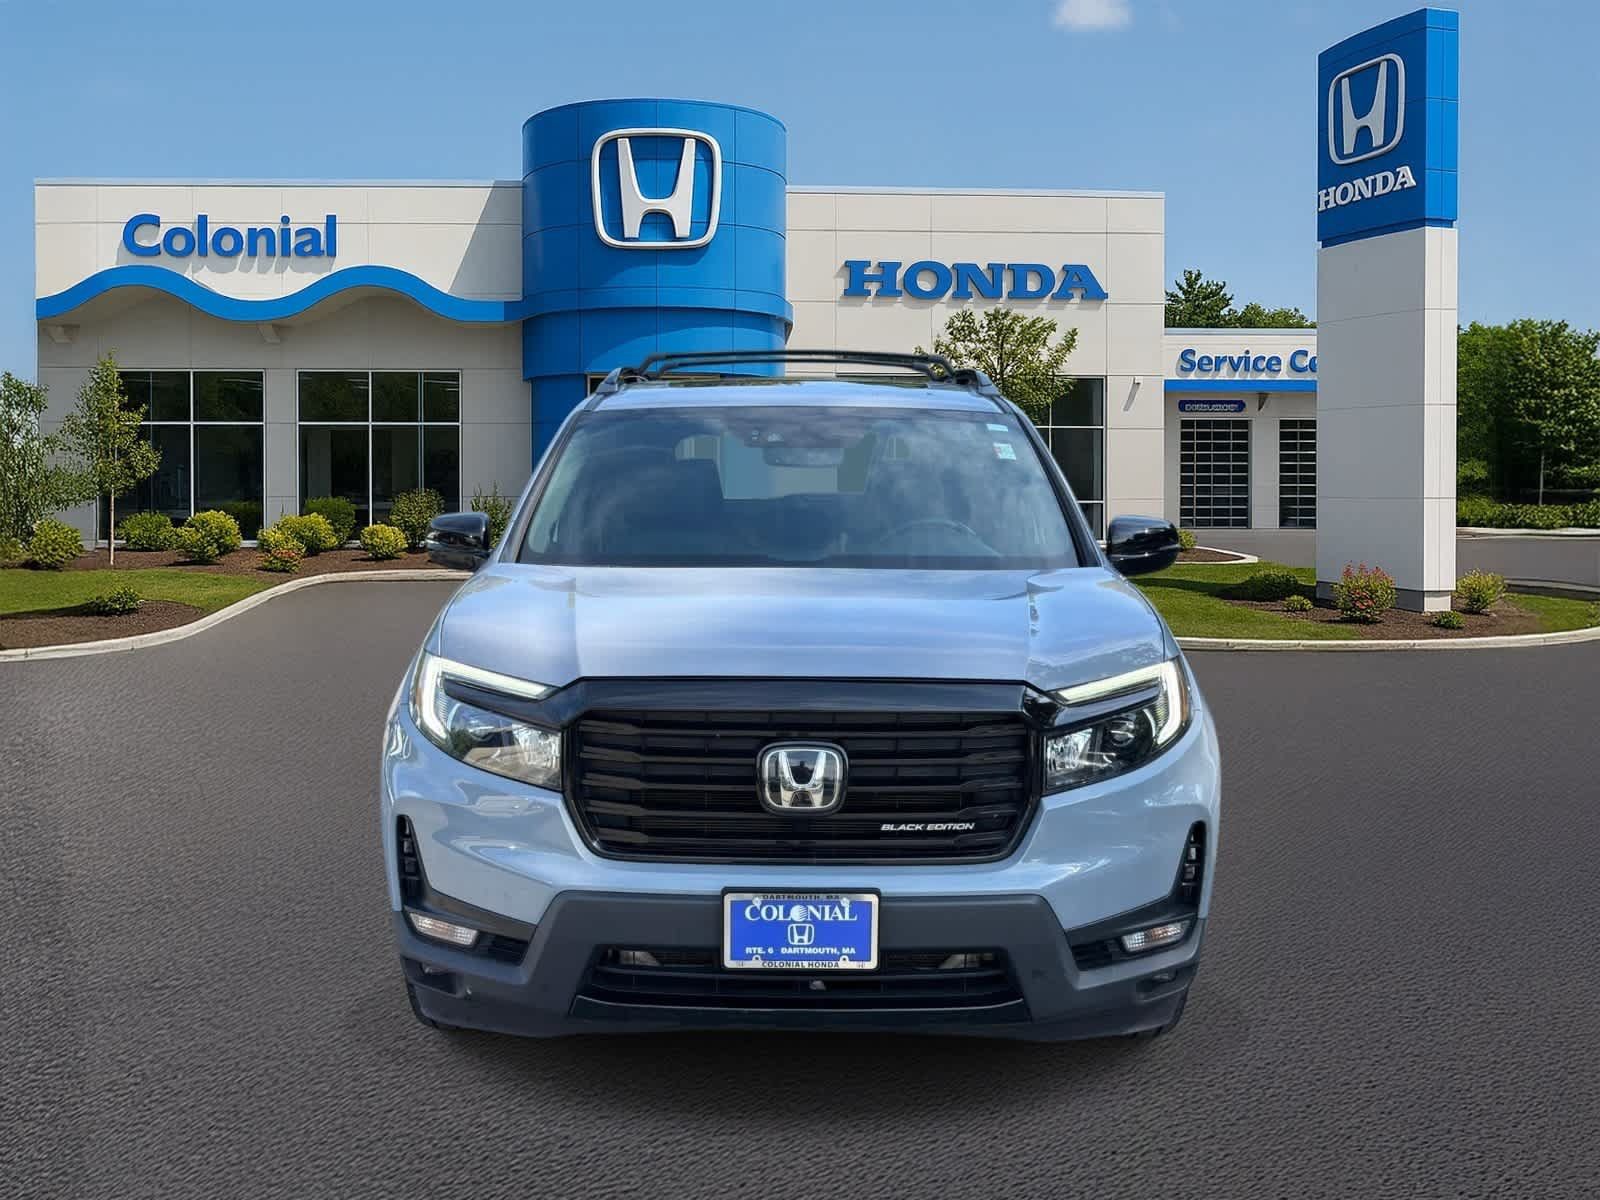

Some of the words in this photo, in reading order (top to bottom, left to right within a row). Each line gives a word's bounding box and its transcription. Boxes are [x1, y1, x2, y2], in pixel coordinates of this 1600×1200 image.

[1318, 165, 1417, 212] HONDA
[122, 213, 337, 257] Colonial
[843, 260, 1109, 300] HONDA
[1180, 348, 1282, 373] Service
[881, 823, 925, 831] BLACK
[926, 822, 975, 831] EDITION
[744, 904, 857, 922] COLONIAL
[780, 947, 840, 955] DARTMOUTH,
[761, 961, 805, 969] COLONIAL
[807, 961, 840, 969] HONDA
